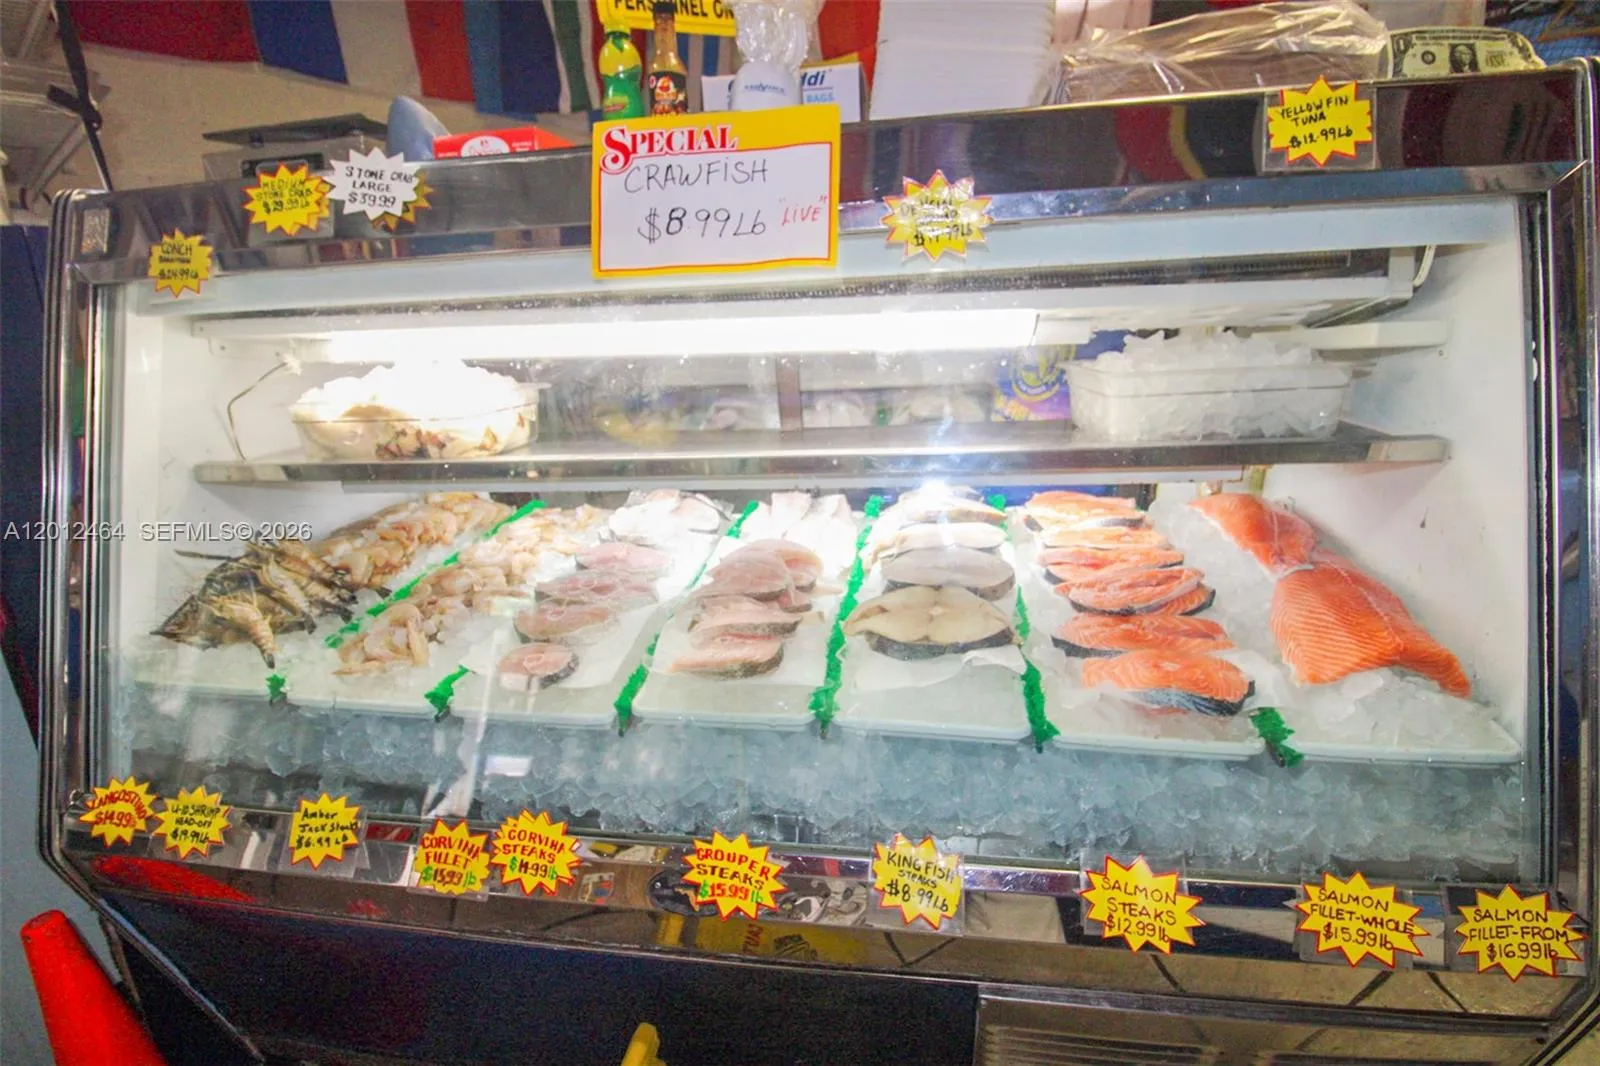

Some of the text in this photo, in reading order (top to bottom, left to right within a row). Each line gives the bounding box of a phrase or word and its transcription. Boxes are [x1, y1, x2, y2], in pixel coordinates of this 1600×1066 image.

[615, 0, 708, 17] PERSNEL
[1276, 101, 1323, 119] YELLOW
[1291, 112, 1327, 126] TUNA
[603, 128, 737, 170] SPECIAL
[345, 166, 385, 181] STONE
[352, 181, 392, 192] LARGE
[302, 808, 338, 821] Amber
[422, 836, 481, 859] CORVINA
[502, 844, 556, 864] STEAKS
[425, 851, 472, 869] FILLET
[696, 848, 770, 881] GROUPER
[887, 852, 921, 871] KING
[696, 863, 765, 890] STEAKS
[898, 870, 937, 888] STEAKS
[1101, 877, 1177, 905] SALMON
[1318, 888, 1389, 912] SALMON
[1107, 897, 1177, 926] STEAKS
[1473, 909, 1548, 922] SALMON
